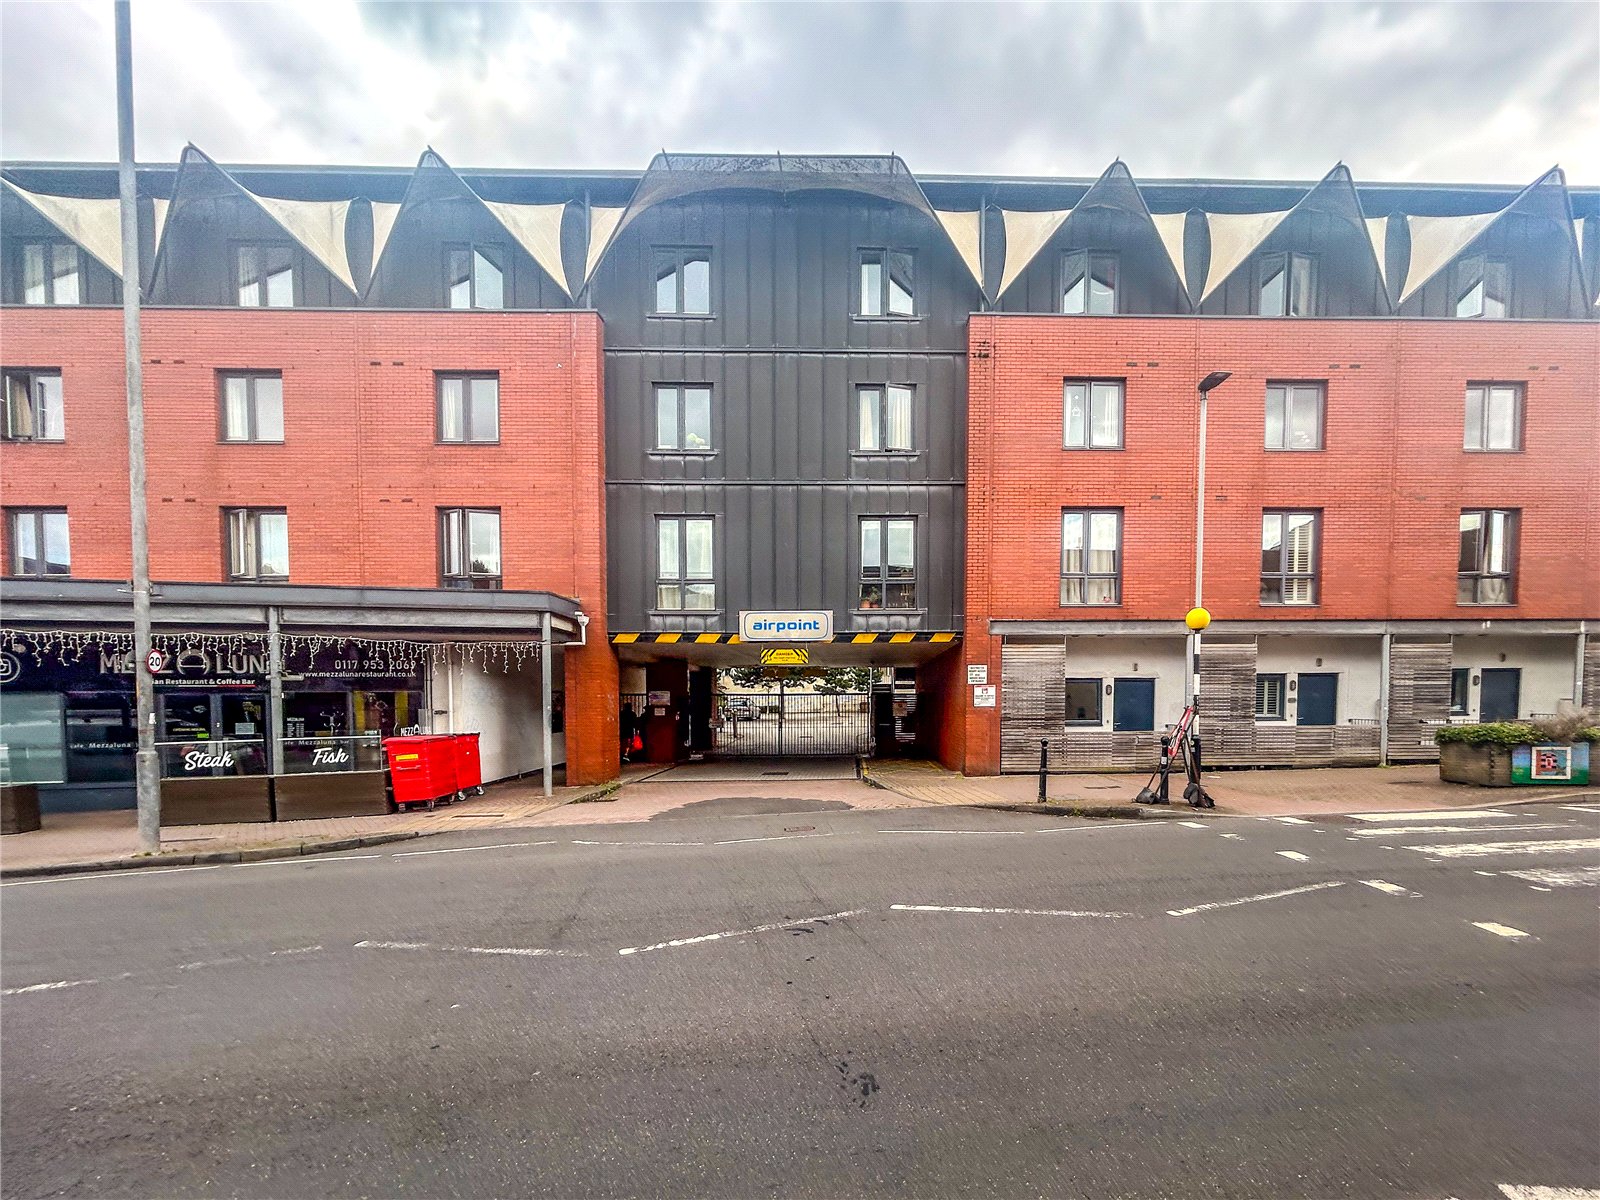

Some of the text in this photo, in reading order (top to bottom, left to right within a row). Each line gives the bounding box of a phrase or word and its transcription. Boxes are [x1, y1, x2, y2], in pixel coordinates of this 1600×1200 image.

[752, 619, 820, 632] airpoint
[149, 656, 161, 667] 20
[334, 660, 417, 670] 0117 953 2069
[184, 750, 234, 771] Steak
[312, 747, 349, 766] Fish
